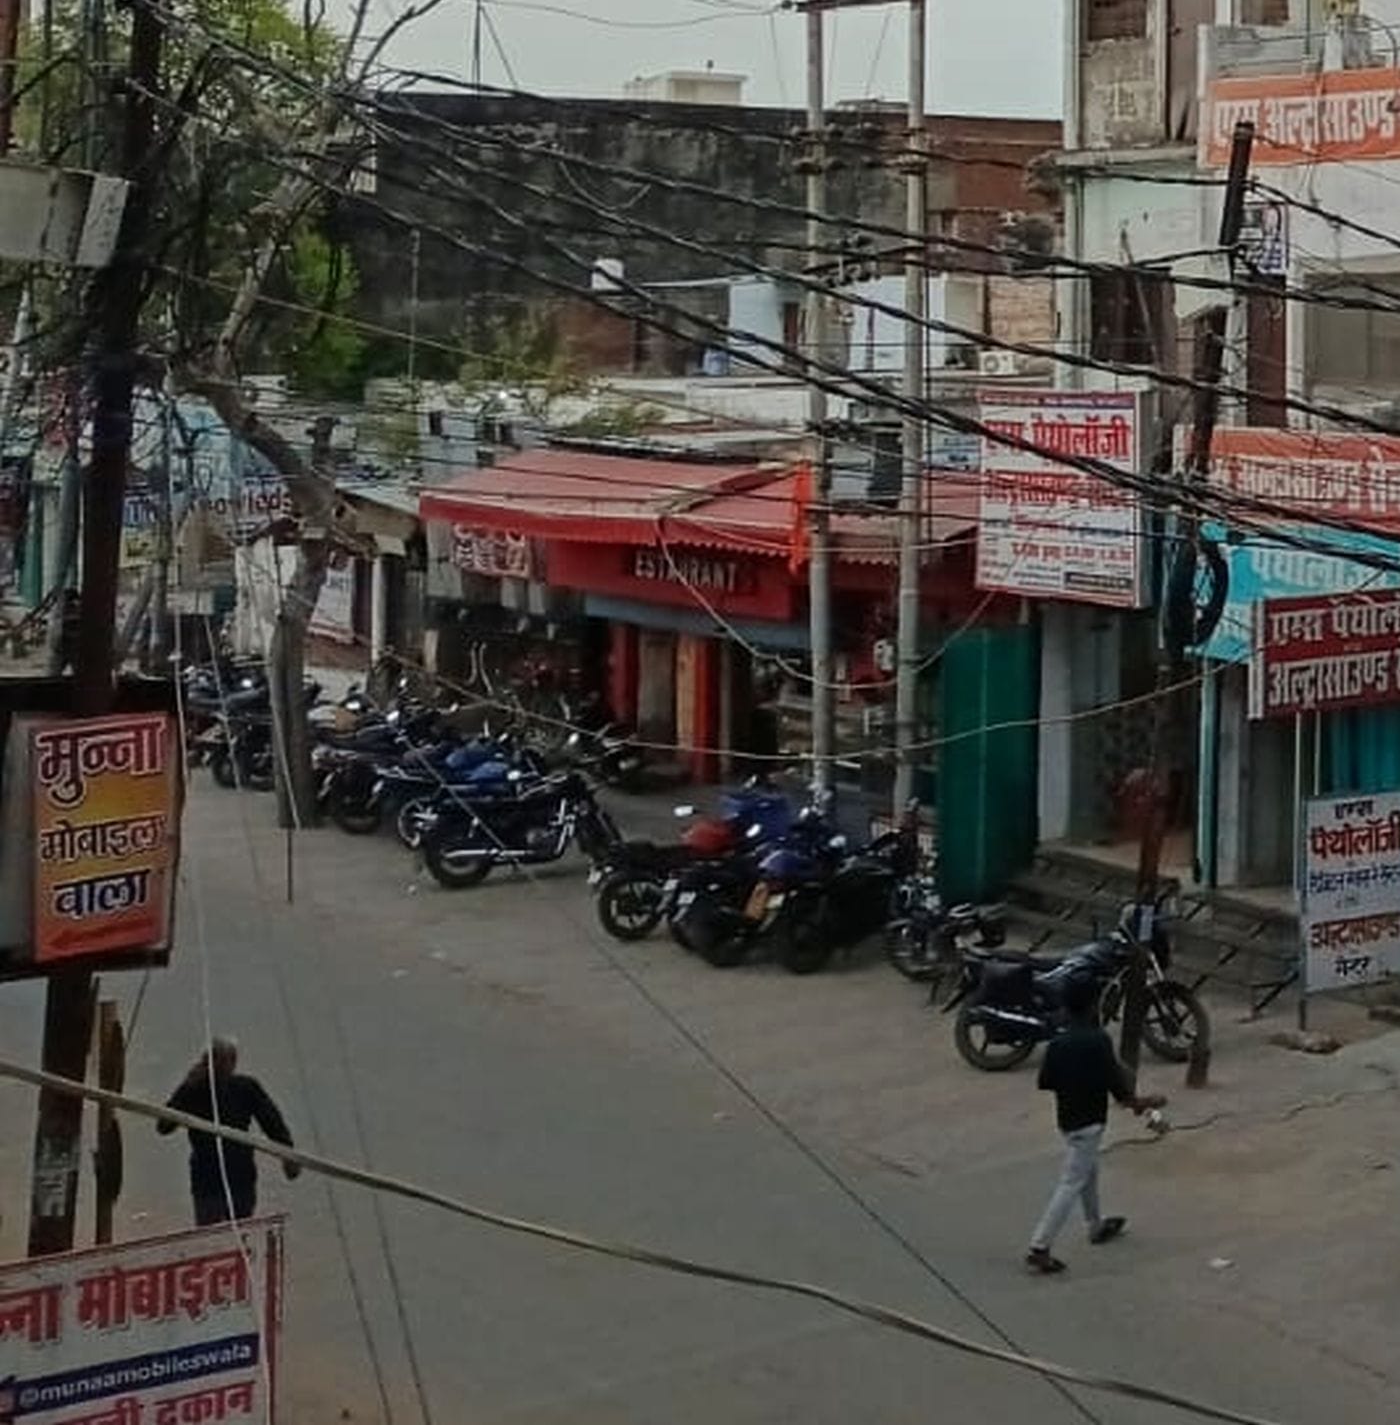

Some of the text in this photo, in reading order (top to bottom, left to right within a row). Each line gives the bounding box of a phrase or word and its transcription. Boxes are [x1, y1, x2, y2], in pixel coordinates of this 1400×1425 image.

[37, 718, 165, 809] मुन्ना
[40, 817, 165, 862] मोबाइल
[53, 868, 152, 918] वाला
[75, 1248, 251, 1330] मोबाइल
